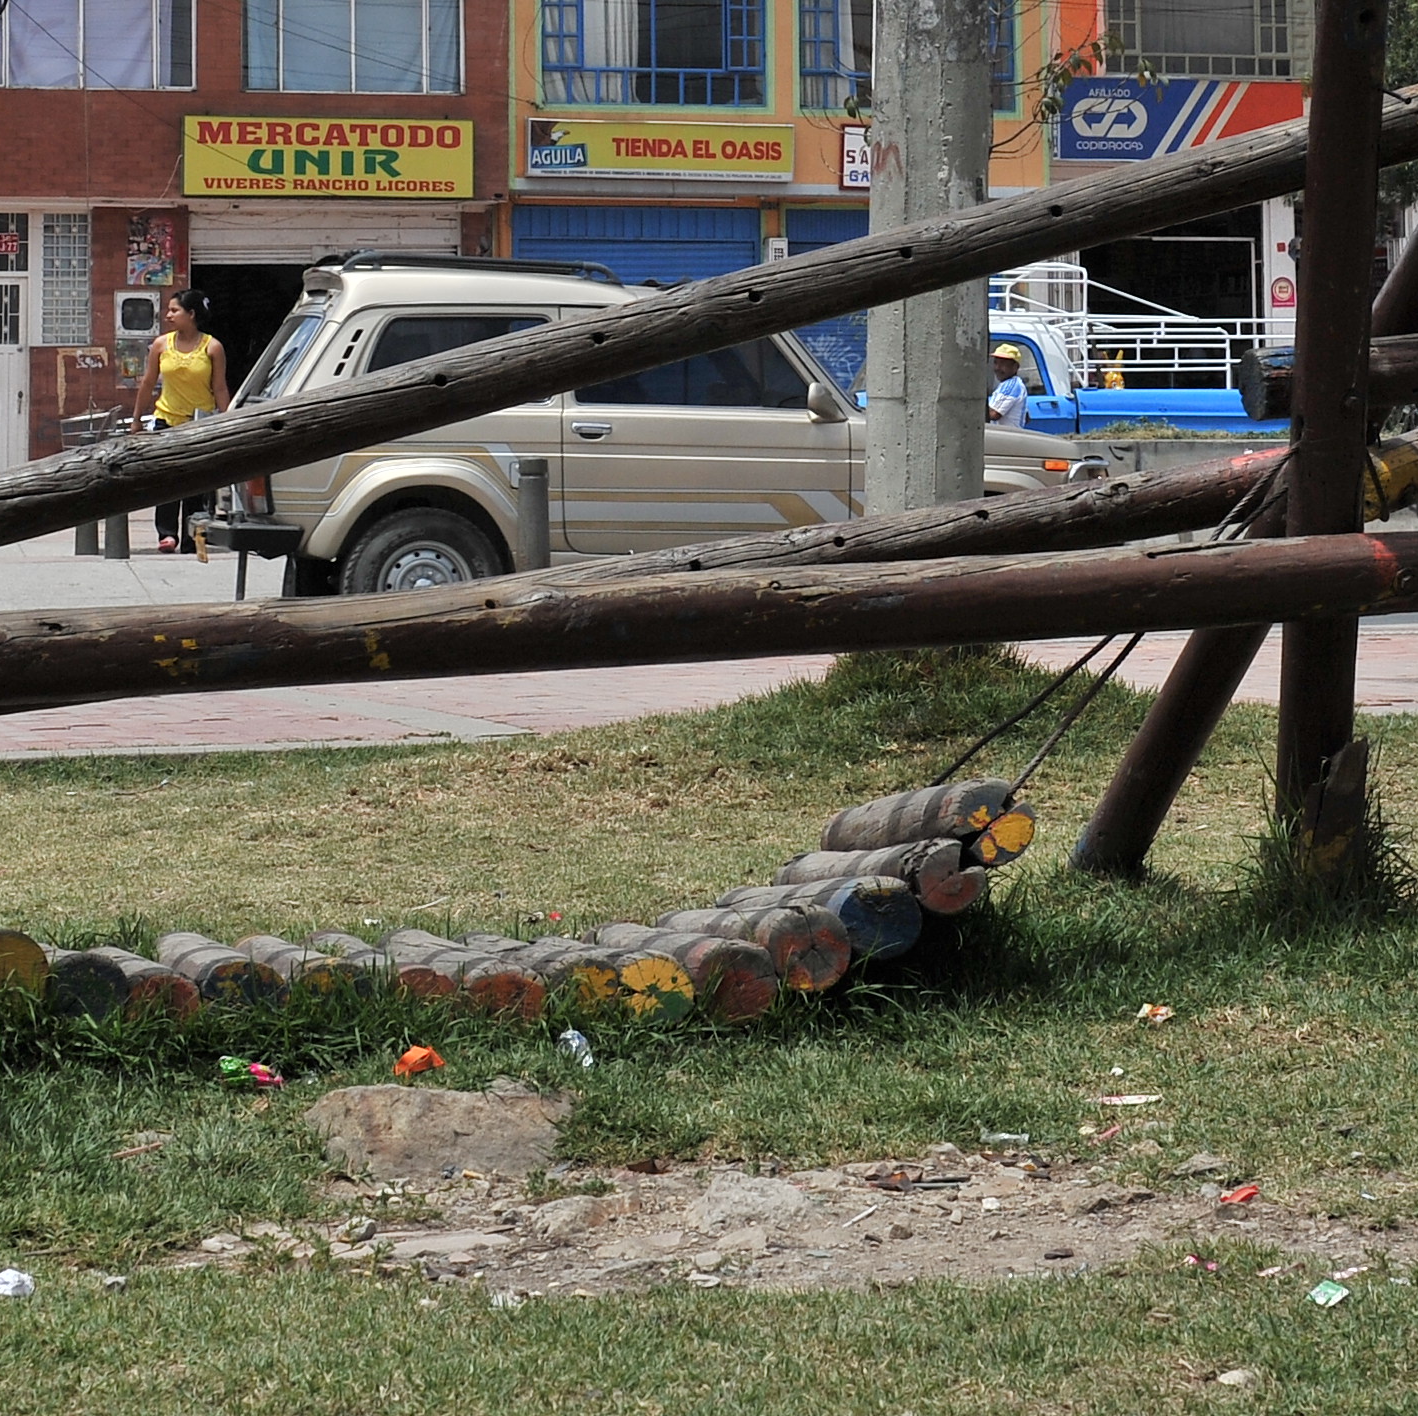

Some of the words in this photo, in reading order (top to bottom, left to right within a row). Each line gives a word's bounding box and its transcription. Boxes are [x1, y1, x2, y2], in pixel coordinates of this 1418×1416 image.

[196, 120, 462, 149] MERCATODO
[531, 147, 585, 166] AGUILA
[612, 137, 689, 159] TIENDA
[692, 139, 717, 160] EL
[720, 140, 783, 162] OASIS
[846, 149, 869, 165] SA
[247, 148, 402, 178] UNIR
[203, 177, 287, 192] VIVERES
[292, 178, 370, 192] RANCHO
[375, 179, 456, 193] LICORES
[849, 170, 870, 182] GA
